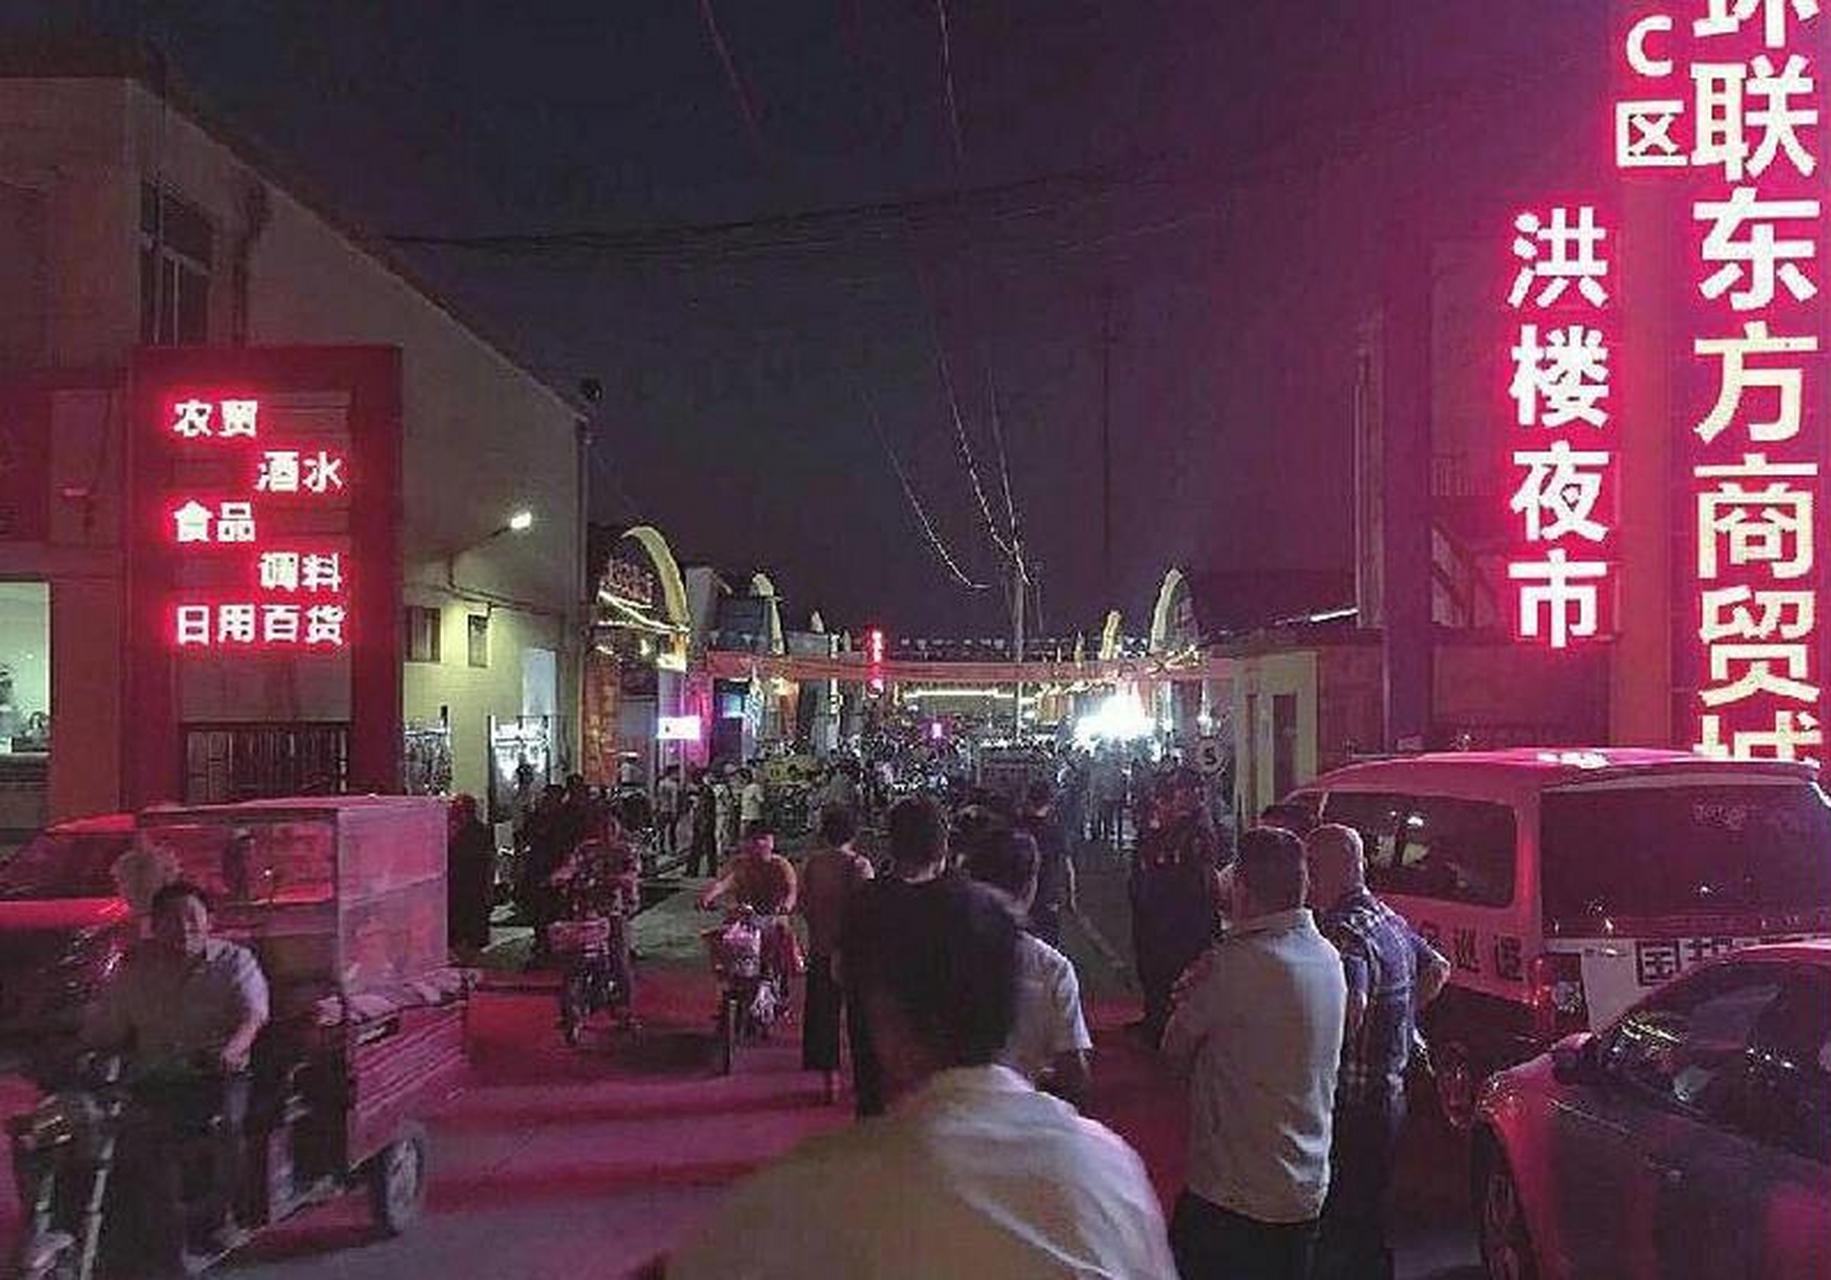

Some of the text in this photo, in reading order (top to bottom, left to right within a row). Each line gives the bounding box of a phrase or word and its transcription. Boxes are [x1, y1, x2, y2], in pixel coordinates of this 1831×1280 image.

[1616, 15, 1688, 168] C区
[173, 399, 257, 437] 农贸
[1508, 206, 1610, 648] 洪楼夜市
[254, 450, 343, 492] 酒水
[174, 500, 256, 543] 食品
[257, 552, 343, 592] 调料
[176, 604, 346, 645] 日用百货
